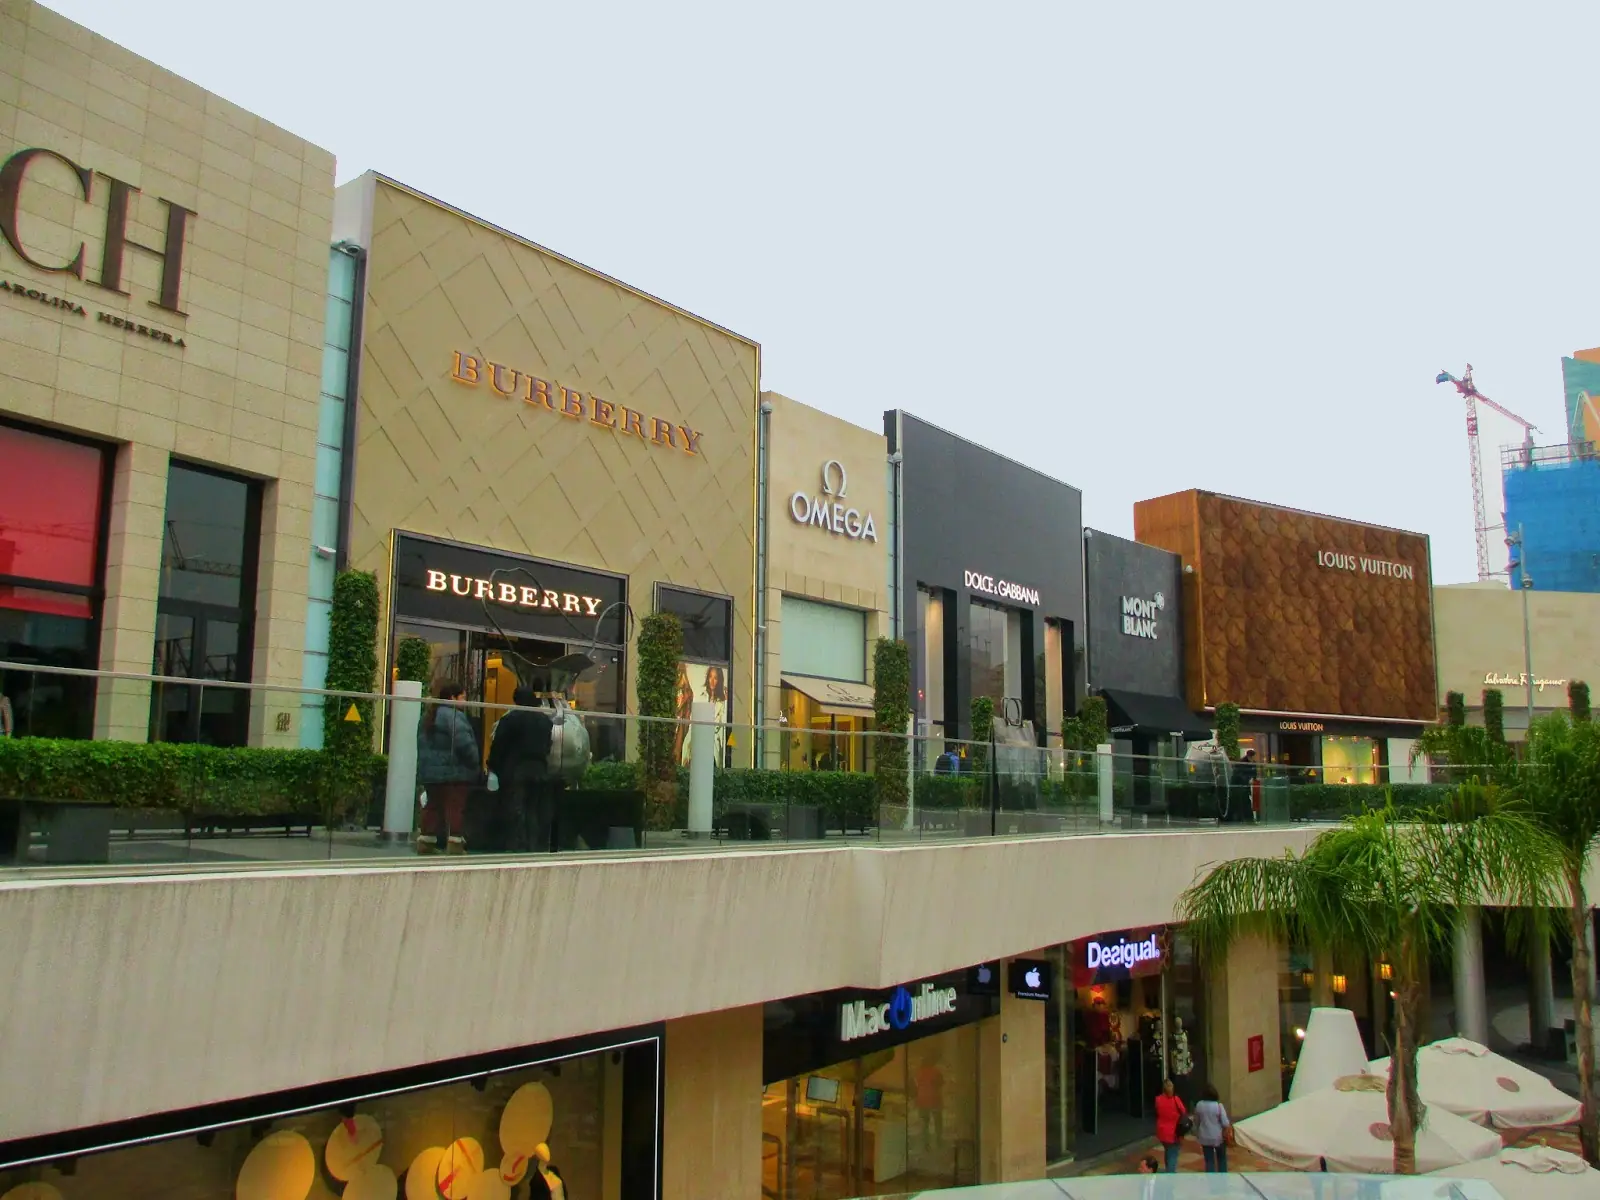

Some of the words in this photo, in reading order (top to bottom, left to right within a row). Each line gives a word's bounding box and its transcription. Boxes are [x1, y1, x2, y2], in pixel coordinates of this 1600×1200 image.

[0, 147, 198, 317] CH
[0, 280, 88, 317] AROLINA
[97, 311, 187, 348] HERRERA
[452, 351, 703, 456] BURBERRY
[790, 491, 878, 543] OMEGA
[1318, 550, 1356, 571] LOUIS
[1359, 556, 1413, 580] VUITTON
[426, 569, 602, 616] BURBERRY
[1122, 595, 1157, 620] MONT
[1122, 615, 1158, 640] BLANC
[1280, 721, 1297, 730] LOUIS
[1298, 721, 1324, 731] VUITTON
